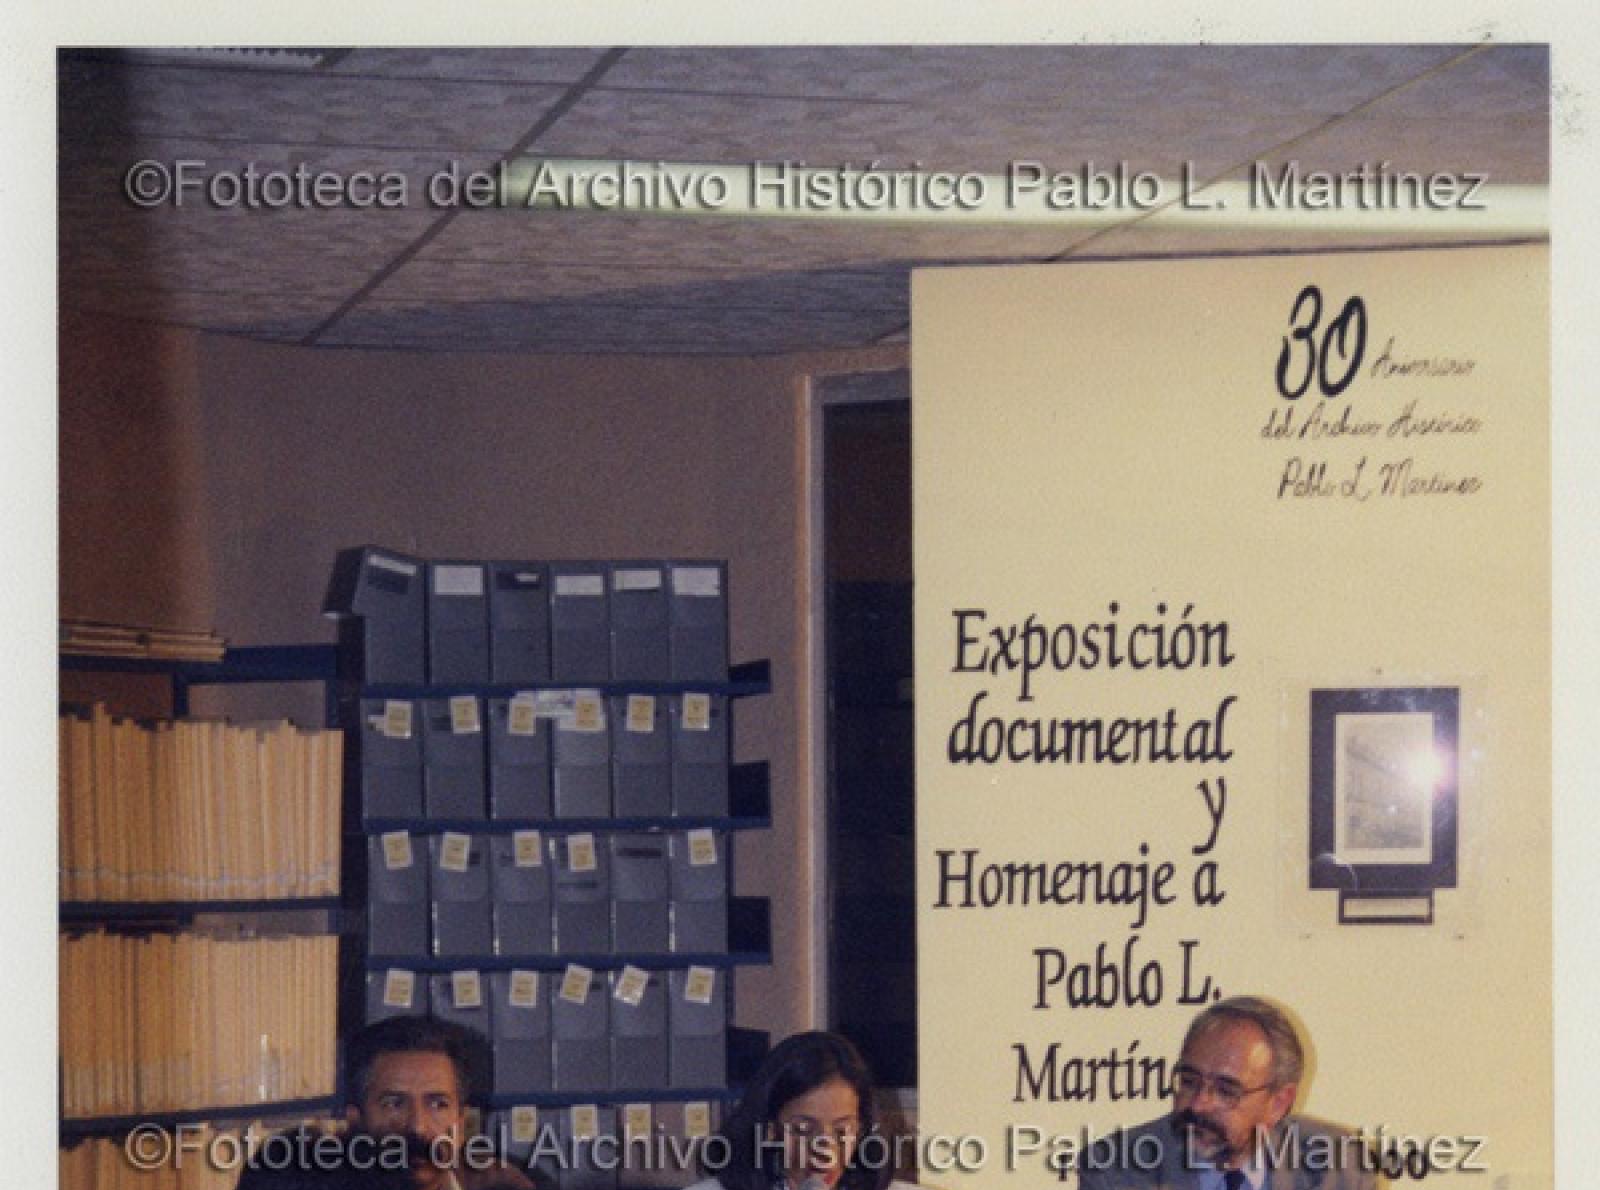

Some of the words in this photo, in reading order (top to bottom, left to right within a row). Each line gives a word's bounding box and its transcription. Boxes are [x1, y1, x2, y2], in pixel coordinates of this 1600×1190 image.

[1275, 285, 1368, 400] 30
[1261, 405, 1296, 440] del
[1298, 400, 1382, 440] Archivo
[1277, 456, 1336, 499] Pablo
[952, 602, 1236, 701] Exposición
[947, 692, 1237, 766] documental
[1192, 776, 1227, 856] y
[933, 843, 1176, 930] Homenaje
[1192, 860, 1226, 907] a
[1032, 936, 1164, 1010] Pablo
[1177, 941, 1223, 1005] L.
